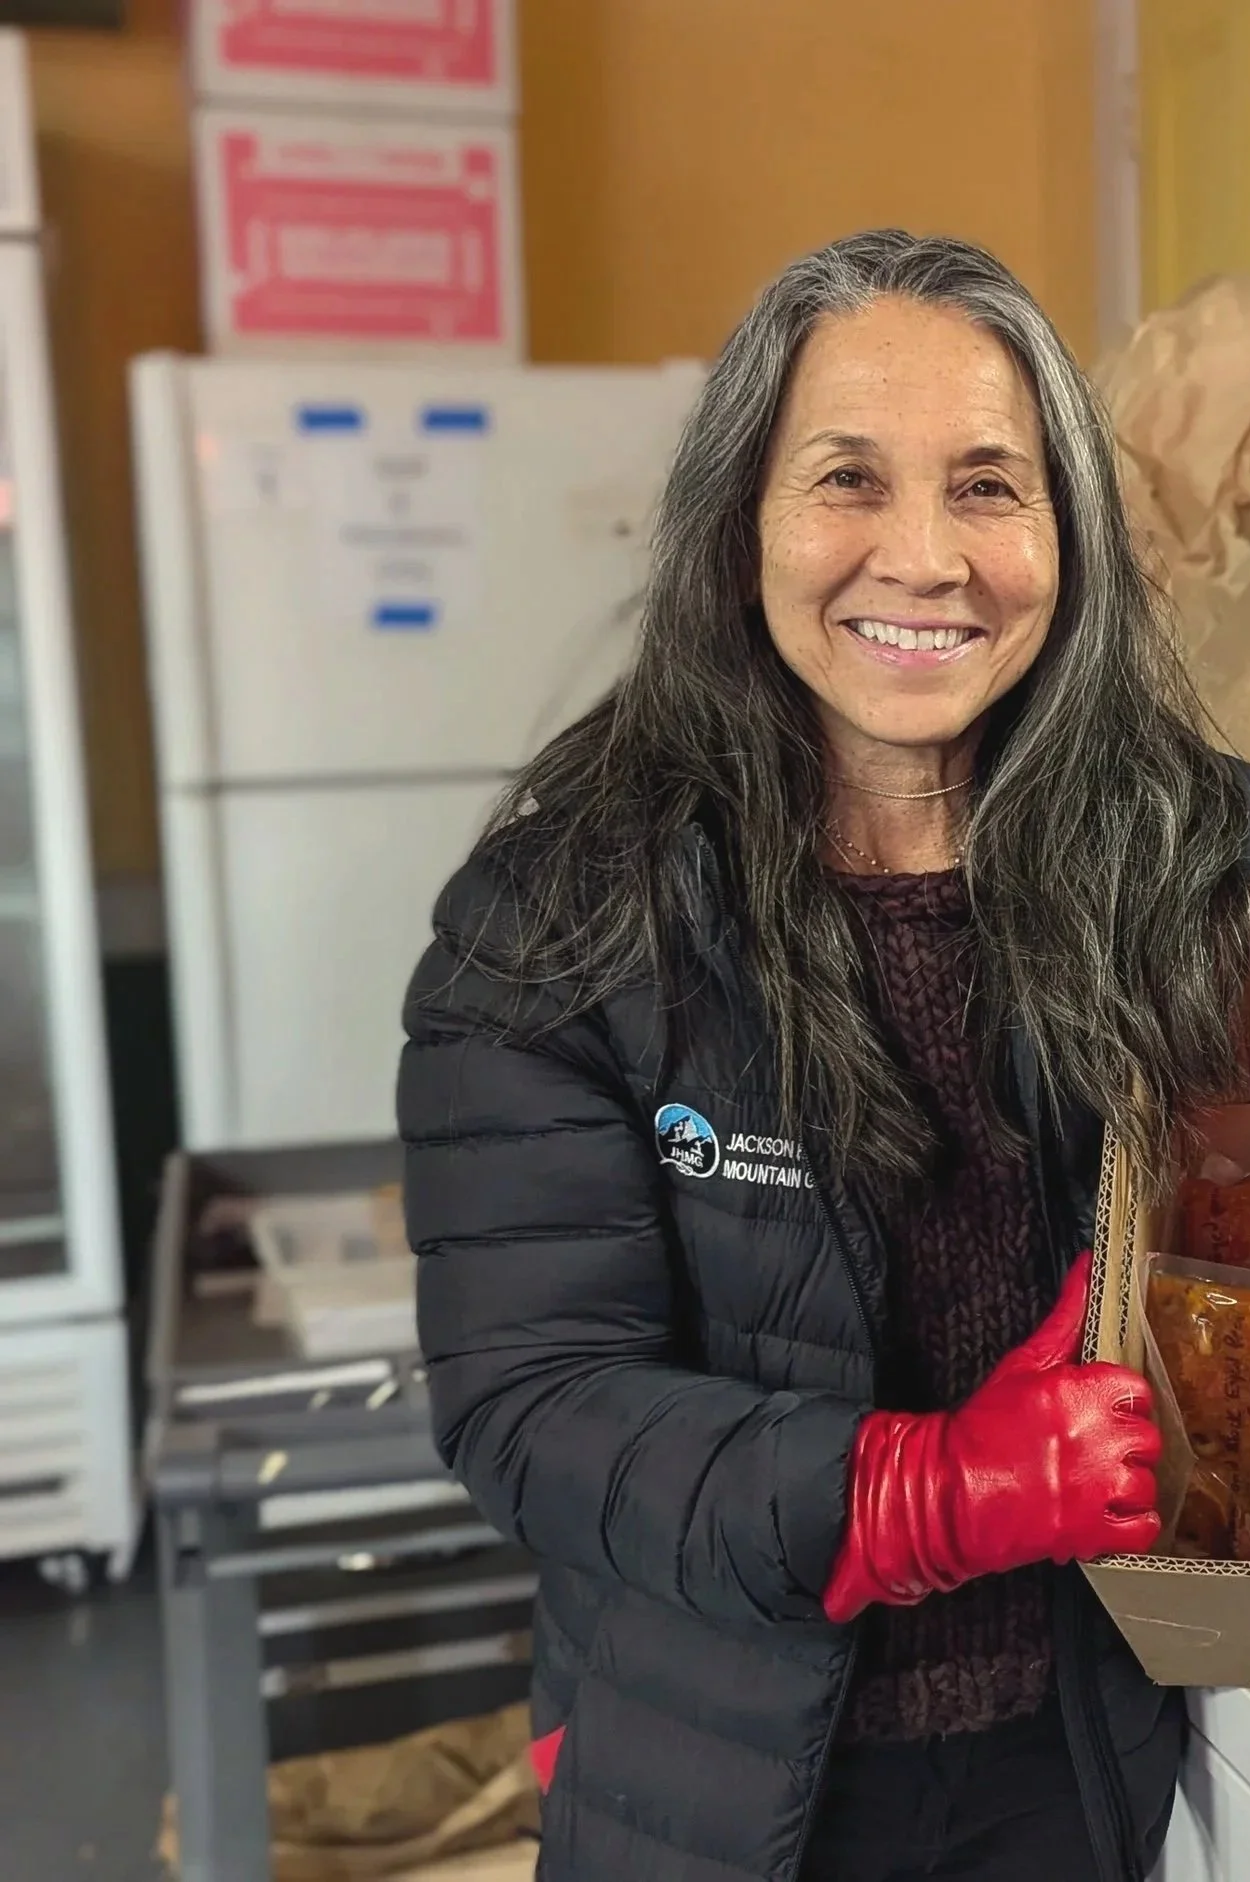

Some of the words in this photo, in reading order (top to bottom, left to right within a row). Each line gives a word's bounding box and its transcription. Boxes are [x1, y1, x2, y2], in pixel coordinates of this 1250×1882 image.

[670, 1146, 703, 1168] JHMG
[726, 1133, 795, 1160] JACKSON
[722, 1159, 801, 1188] MOUNTAIN
